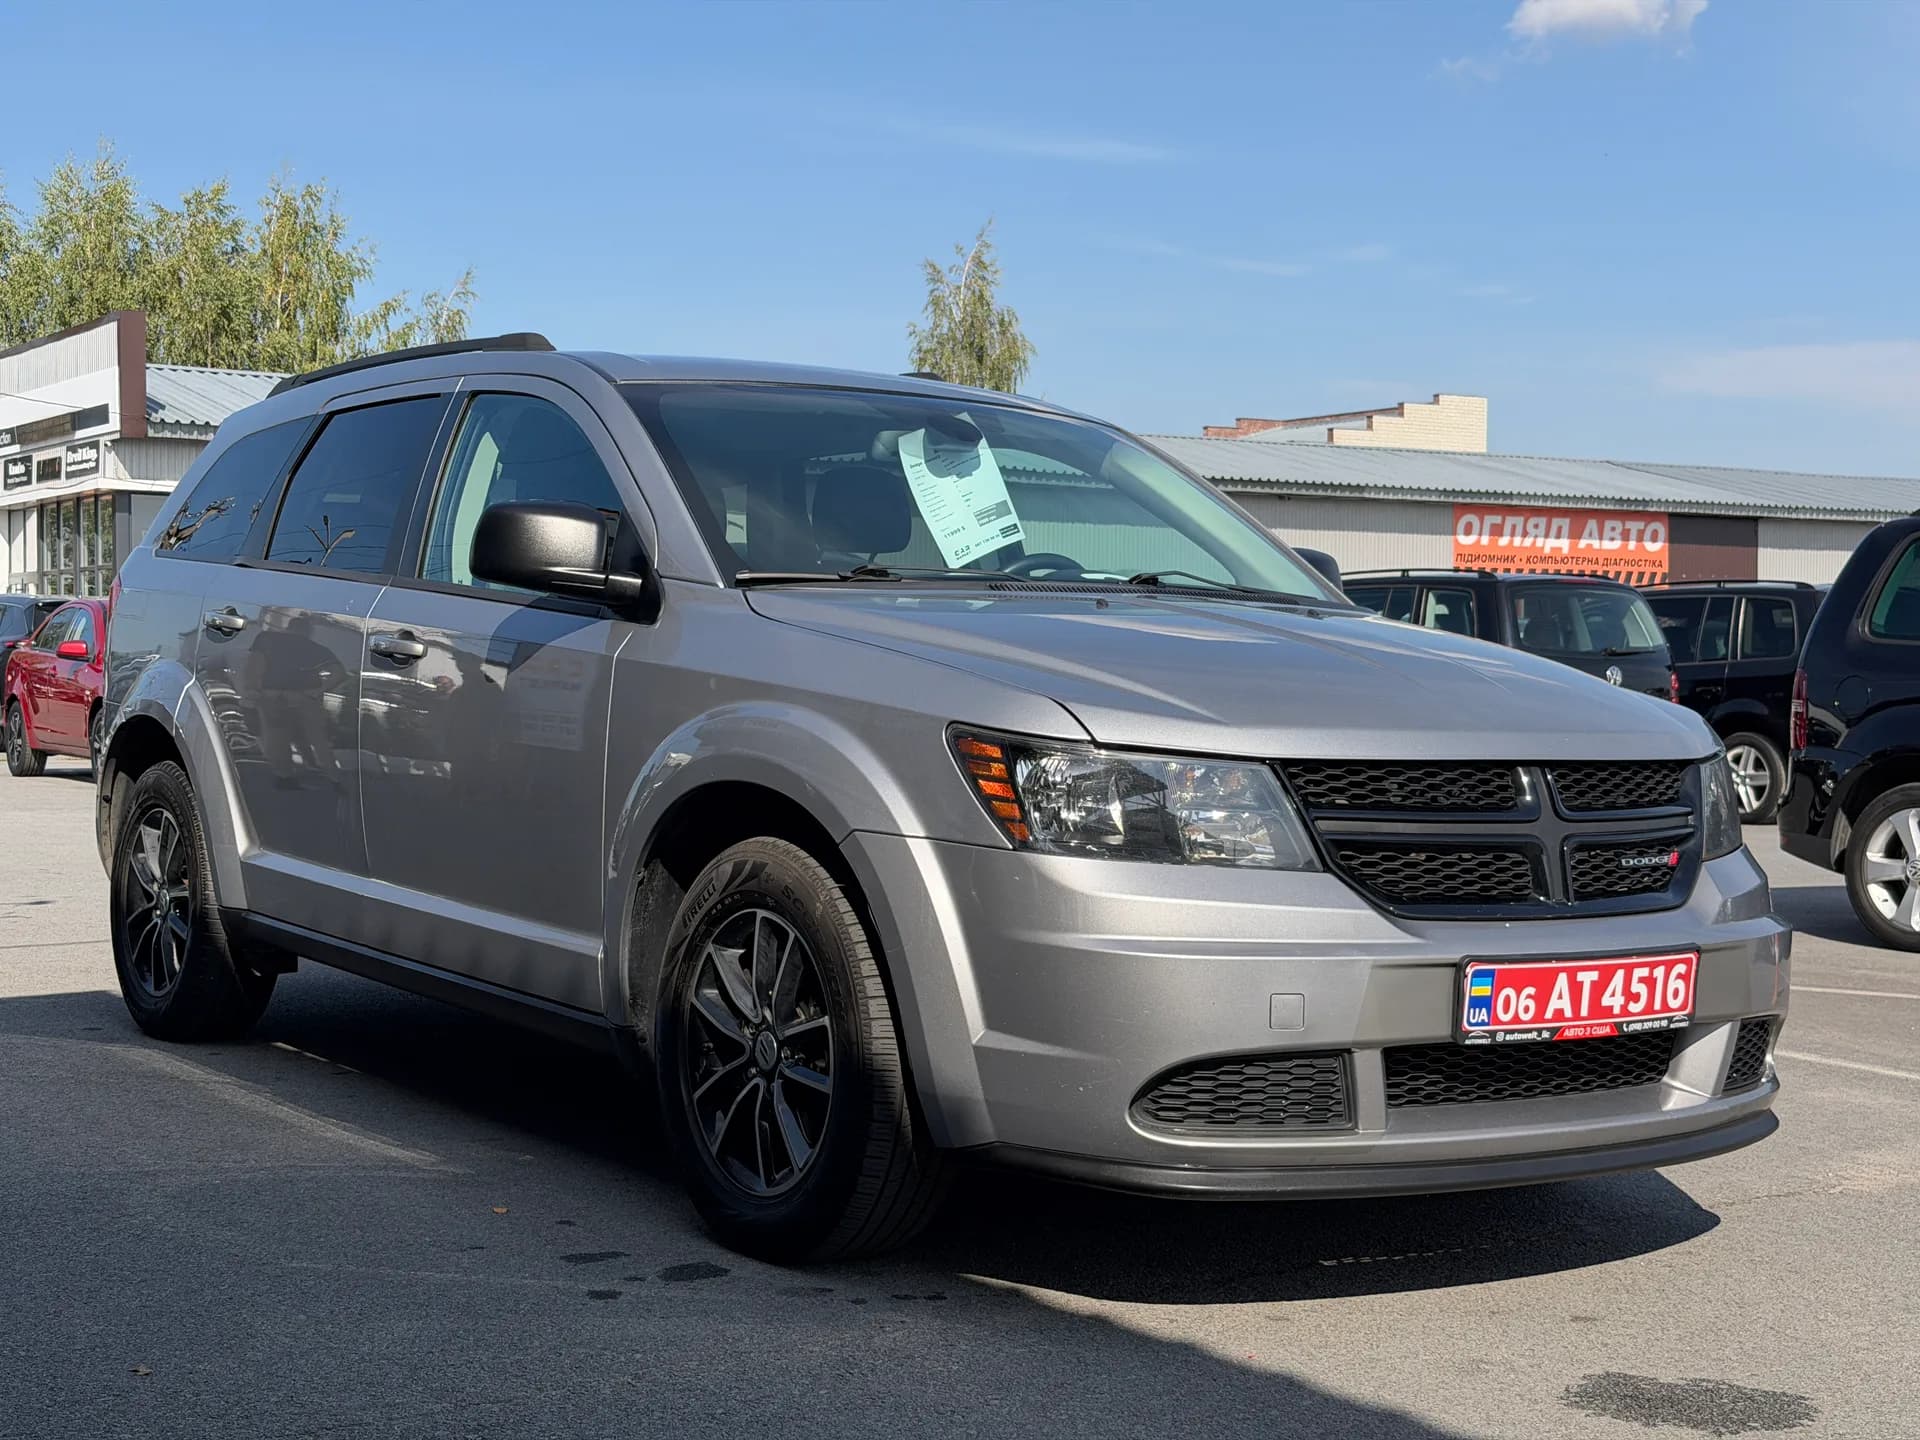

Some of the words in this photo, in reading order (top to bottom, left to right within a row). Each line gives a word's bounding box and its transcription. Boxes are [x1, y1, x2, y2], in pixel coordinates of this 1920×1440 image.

[1456, 513, 1570, 554] ОГЛЯД
[1578, 519, 1666, 552] АВТО
[1601, 557, 1663, 569] ДІАГНОСТІКА
[1621, 855, 1670, 866] DODGE
[1496, 986, 1537, 1023] 06
[1544, 971, 1599, 1019] AT
[1601, 963, 1687, 1014] 4516
[1469, 1008, 1488, 1023] UA
[1563, 1028, 1584, 1036] АВТО
